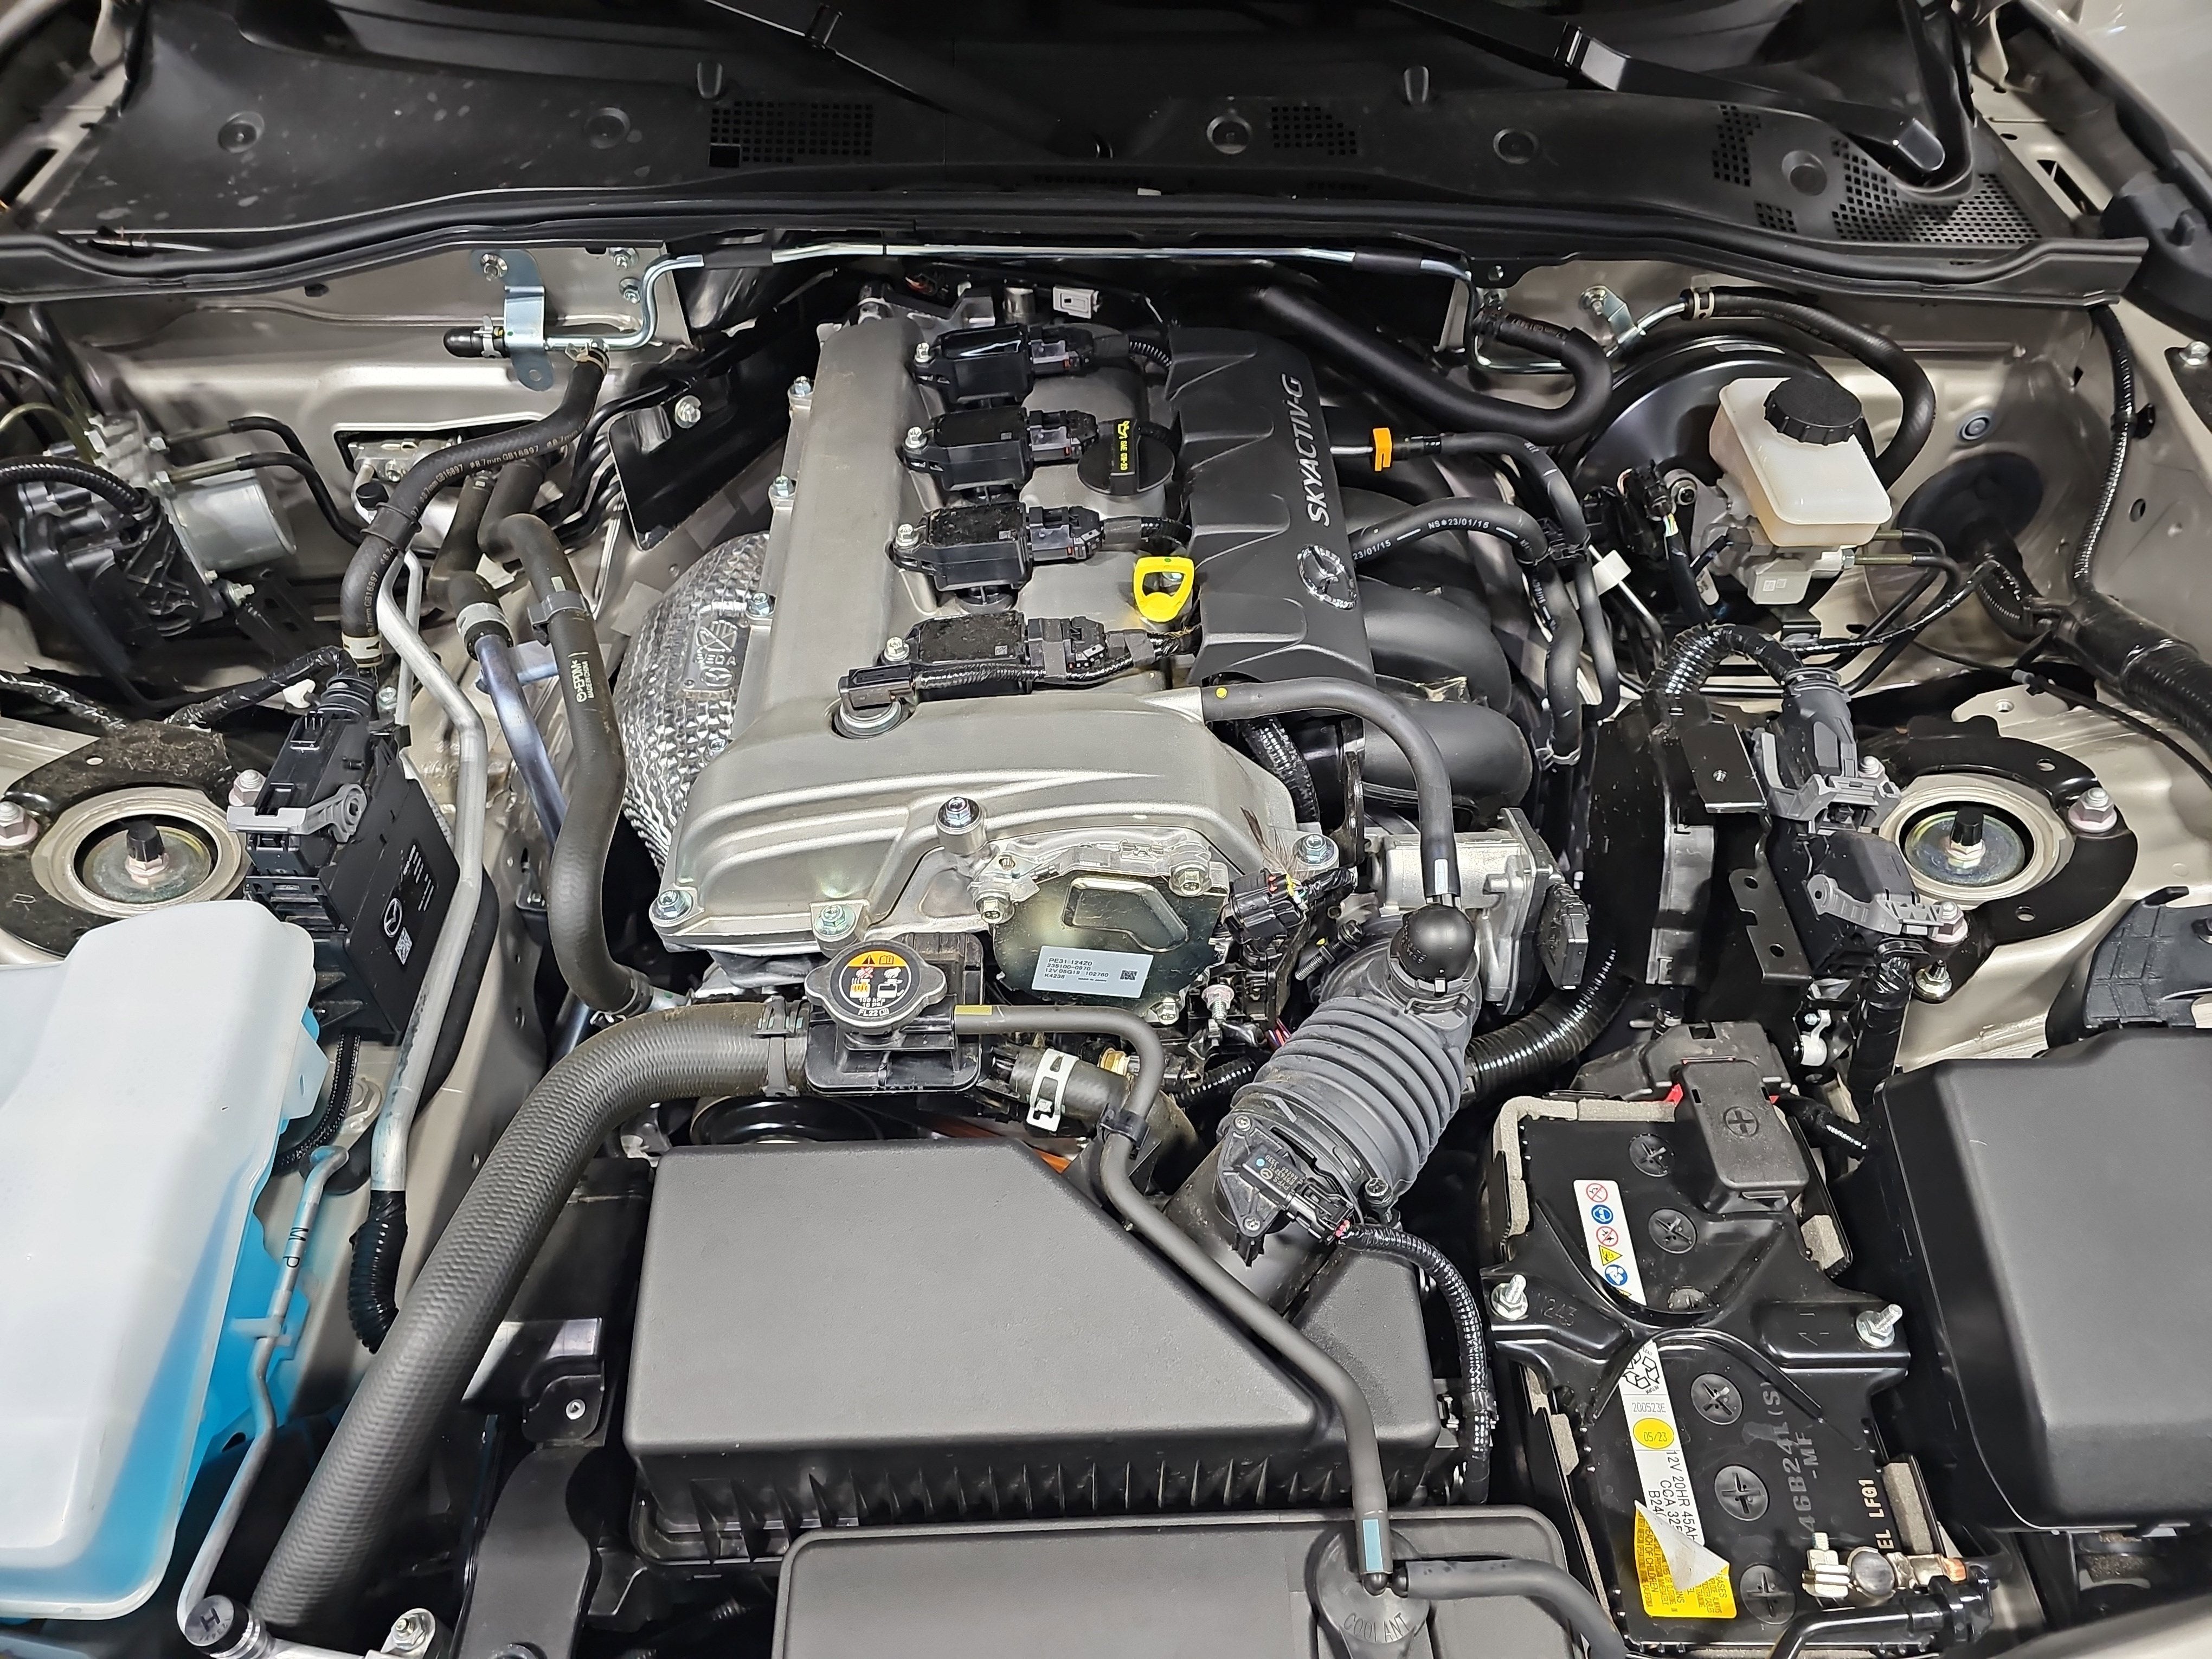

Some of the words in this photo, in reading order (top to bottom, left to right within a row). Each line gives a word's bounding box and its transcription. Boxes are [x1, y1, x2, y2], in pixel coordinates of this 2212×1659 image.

[502, 445, 539, 462] GB16897
[1120, 440, 1128, 452] SAE
[1281, 373, 1330, 527] SKYACTIV-G
[435, 464, 464, 483] GB16897
[1352, 539, 1392, 561] 23/01/15
[364, 571, 379, 607] GB16897
[858, 1008, 878, 1017] FL22
[1272, 1175, 1290, 1191] PYFS
[1631, 1402, 1667, 1413] 200523E
[1643, 1431, 1668, 1442] 05/23
[1666, 1450, 1682, 1472] 12V
[1660, 1480, 1676, 1507] CCA
[1671, 1475, 1690, 1507] 20HR
[1644, 1546, 1654, 1558] OF
[1645, 1558, 1658, 1593] CHILDREN
[200, 1607, 221, 1632] H
